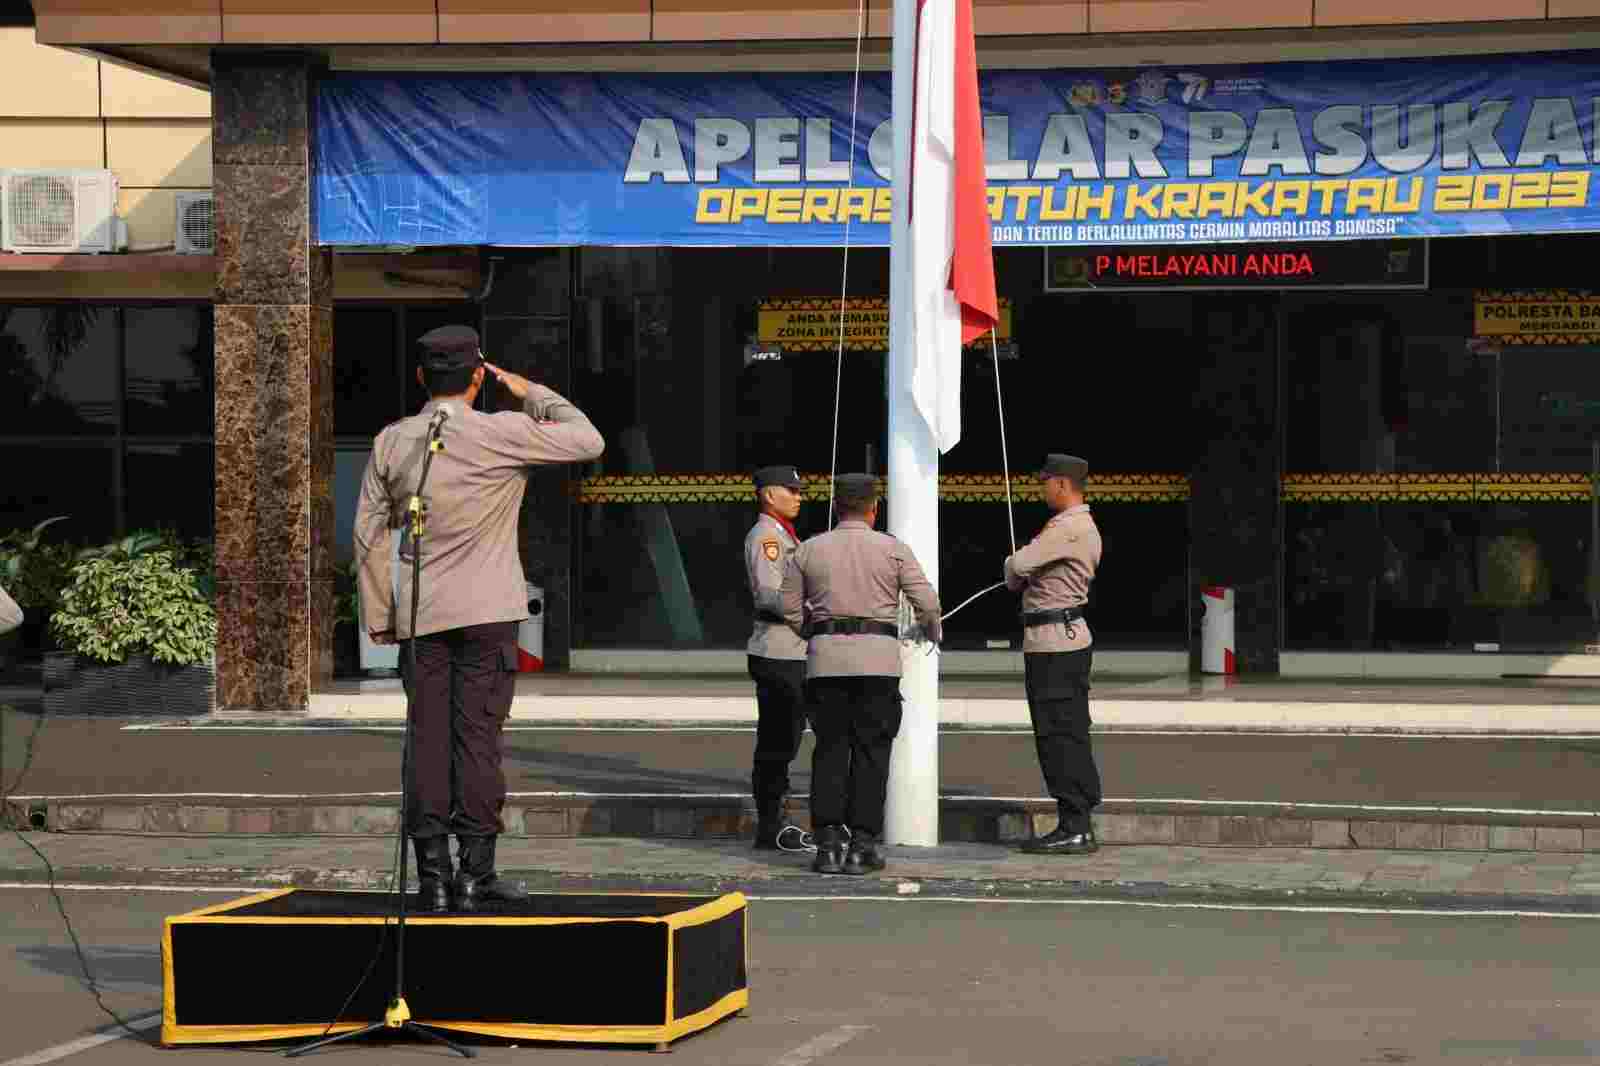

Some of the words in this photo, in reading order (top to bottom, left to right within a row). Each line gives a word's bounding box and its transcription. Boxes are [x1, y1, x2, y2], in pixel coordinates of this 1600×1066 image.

[623, 118, 850, 183] APEL
[867, 113, 1168, 179] LAR
[1188, 98, 1600, 176] PASUKA
[695, 187, 893, 223] OPERAS
[986, 184, 1114, 221] ATUH
[1124, 176, 1425, 219] KRAKATAU
[1433, 171, 1592, 214] 2023
[993, 227, 1022, 241] DAN
[1027, 226, 1073, 241] TERTIB
[1078, 224, 1185, 241] BERLALULINTAS
[1190, 222, 1245, 239] CERMIN
[1249, 219, 1331, 238] MORALITAS
[1096, 255, 1110, 276] P
[1116, 253, 1237, 276] MELAYANI
[1243, 253, 1313, 276] ANDA
[786, 313, 825, 323] ANDA
[1484, 304, 1574, 319] POLRESTA
[777, 327, 816, 337] ZONA
